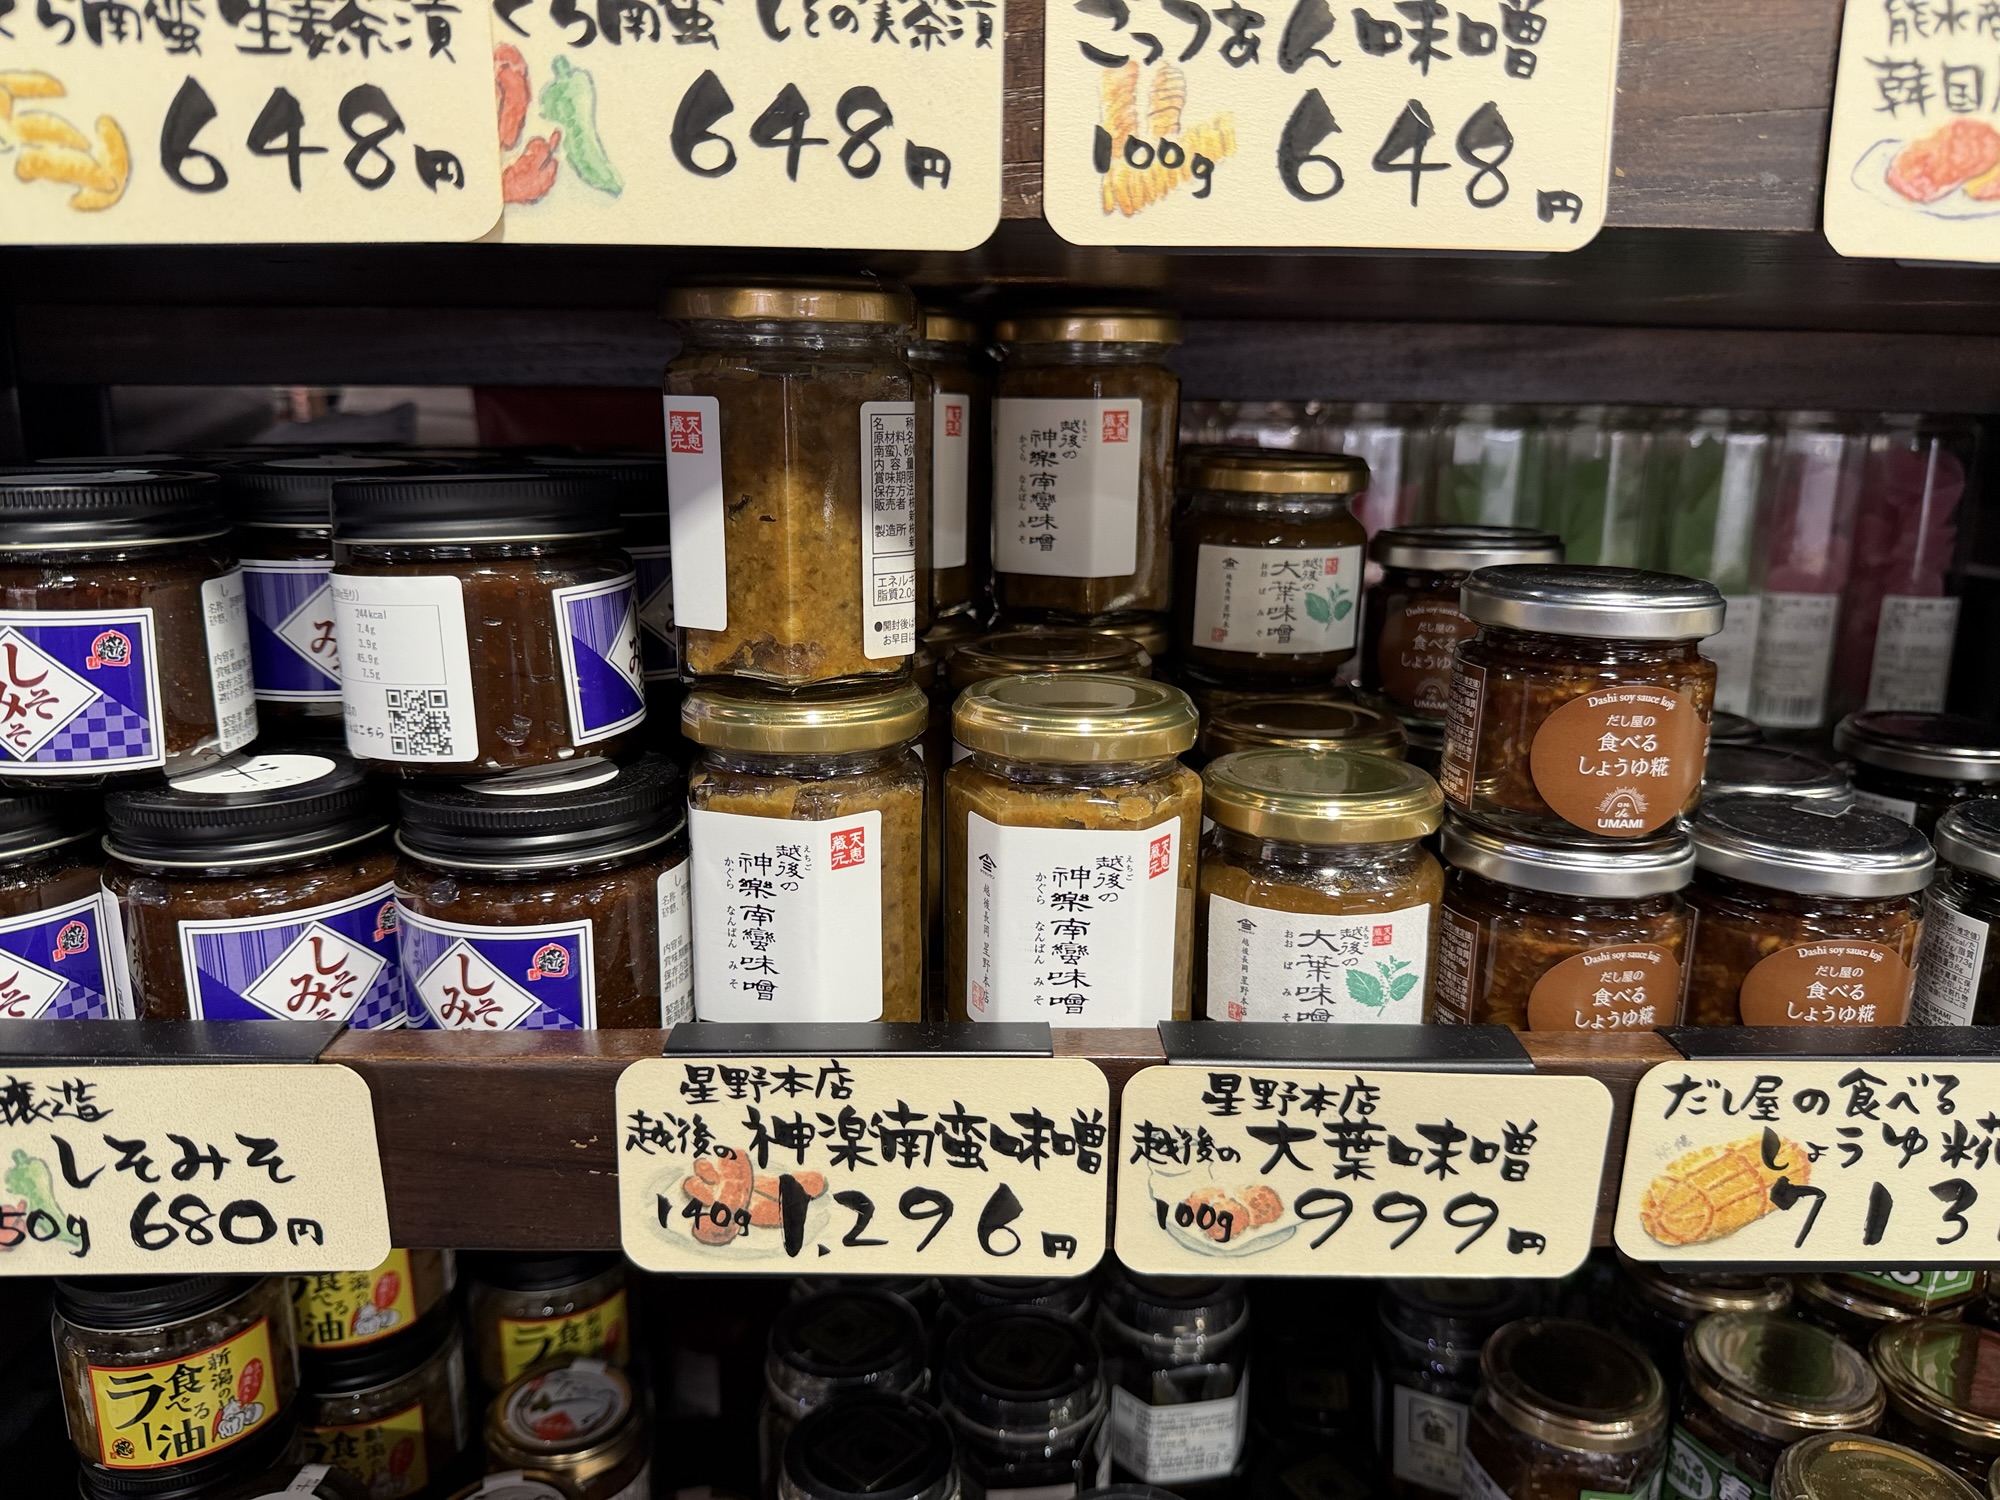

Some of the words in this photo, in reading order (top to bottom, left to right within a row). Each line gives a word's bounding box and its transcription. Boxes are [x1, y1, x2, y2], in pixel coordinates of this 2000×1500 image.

[1864, 56, 2000, 118] 韓国
[160, 75, 465, 193] 648円
[670, 69, 952, 190] 648円
[1093, 125, 1216, 198] 100g
[1276, 88, 1583, 223] 648円
[873, 430, 914, 445] 原材料名
[873, 445, 916, 459] 南蛮)、砂
[874, 499, 906, 512] 販売者
[874, 524, 907, 539] 製造所
[1587, 693, 1618, 707] Dashi
[1619, 693, 1636, 704] soy
[1636, 694, 1660, 704] sauce
[1606, 714, 1656, 728] だし屋の
[1597, 731, 1658, 752] 食べる
[1578, 755, 1671, 778] しょうゆ糀
[1597, 818, 1644, 829] UMAMI
[724, 856, 735, 891] かぐら
[775, 844, 805, 892] 越後の
[1093, 854, 1125, 903] 越後の
[726, 905, 738, 949] なんばん
[1034, 921, 1046, 966] なんばん
[1337, 925, 1365, 967] 越後の
[1582, 952, 1610, 966] Dashi
[1611, 951, 1627, 962] soy
[1797, 945, 1827, 959] Dashi
[1828, 945, 1845, 957] soy
[1846, 946, 1869, 957] sauce
[1600, 970, 1644, 983] だし屋の
[1814, 965, 1864, 979] だし屋の
[1592, 986, 1647, 1008] 食べる
[1806, 981, 1866, 1001] 食べる
[1575, 1005, 1656, 1030] しょうゆ糀
[1786, 1001, 1877, 1024] しょうゆ糀
[680, 1059, 855, 1105] 星野本店
[1201, 1073, 1381, 1118] 星野本店
[1662, 1067, 1961, 1121] だし屋の食べる
[50, 1131, 296, 1189] しそみそ
[655, 1193, 752, 1237] 140g
[1155, 1199, 1233, 1243] 100g
[1293, 1187, 1548, 1257] 999円
[1769, 1175, 2000, 1249] 713
